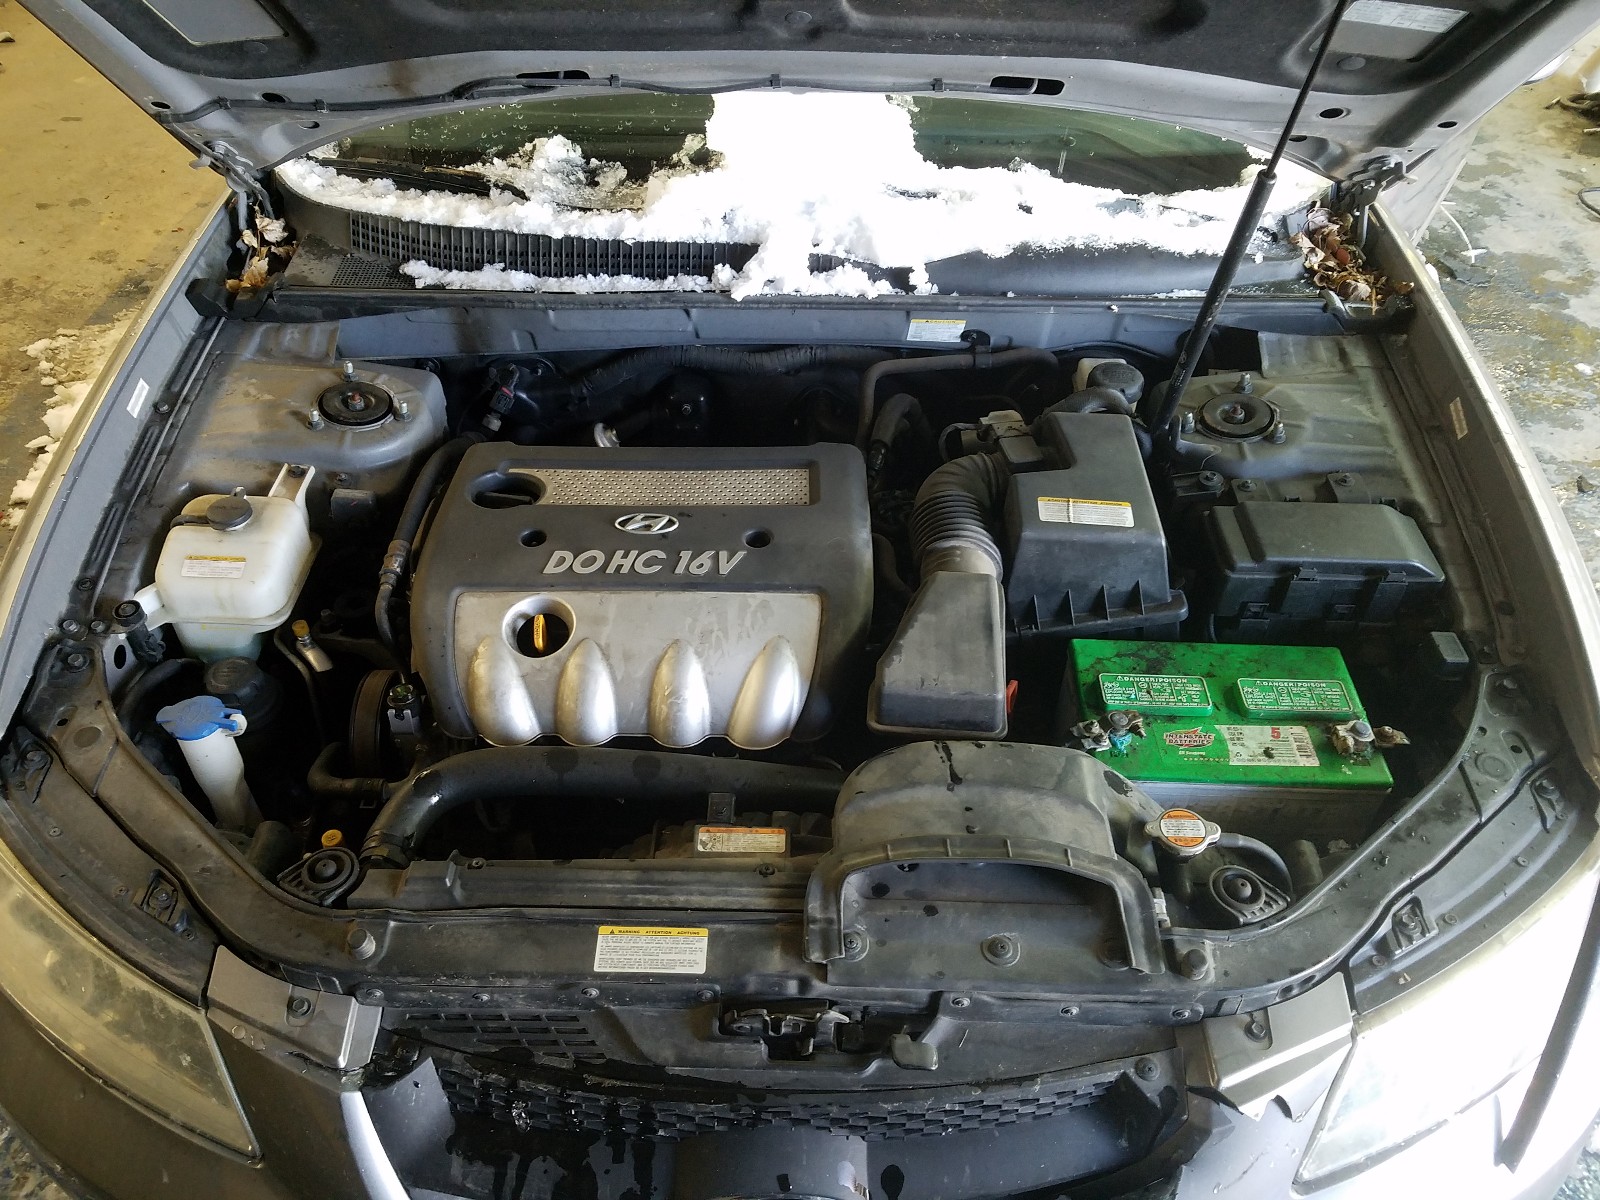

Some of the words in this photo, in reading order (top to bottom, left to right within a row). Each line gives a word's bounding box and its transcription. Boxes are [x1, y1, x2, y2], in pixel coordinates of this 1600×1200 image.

[542, 550, 667, 574] DOHC
[673, 550, 748, 575] 16V
[1270, 727, 1282, 740] 5
